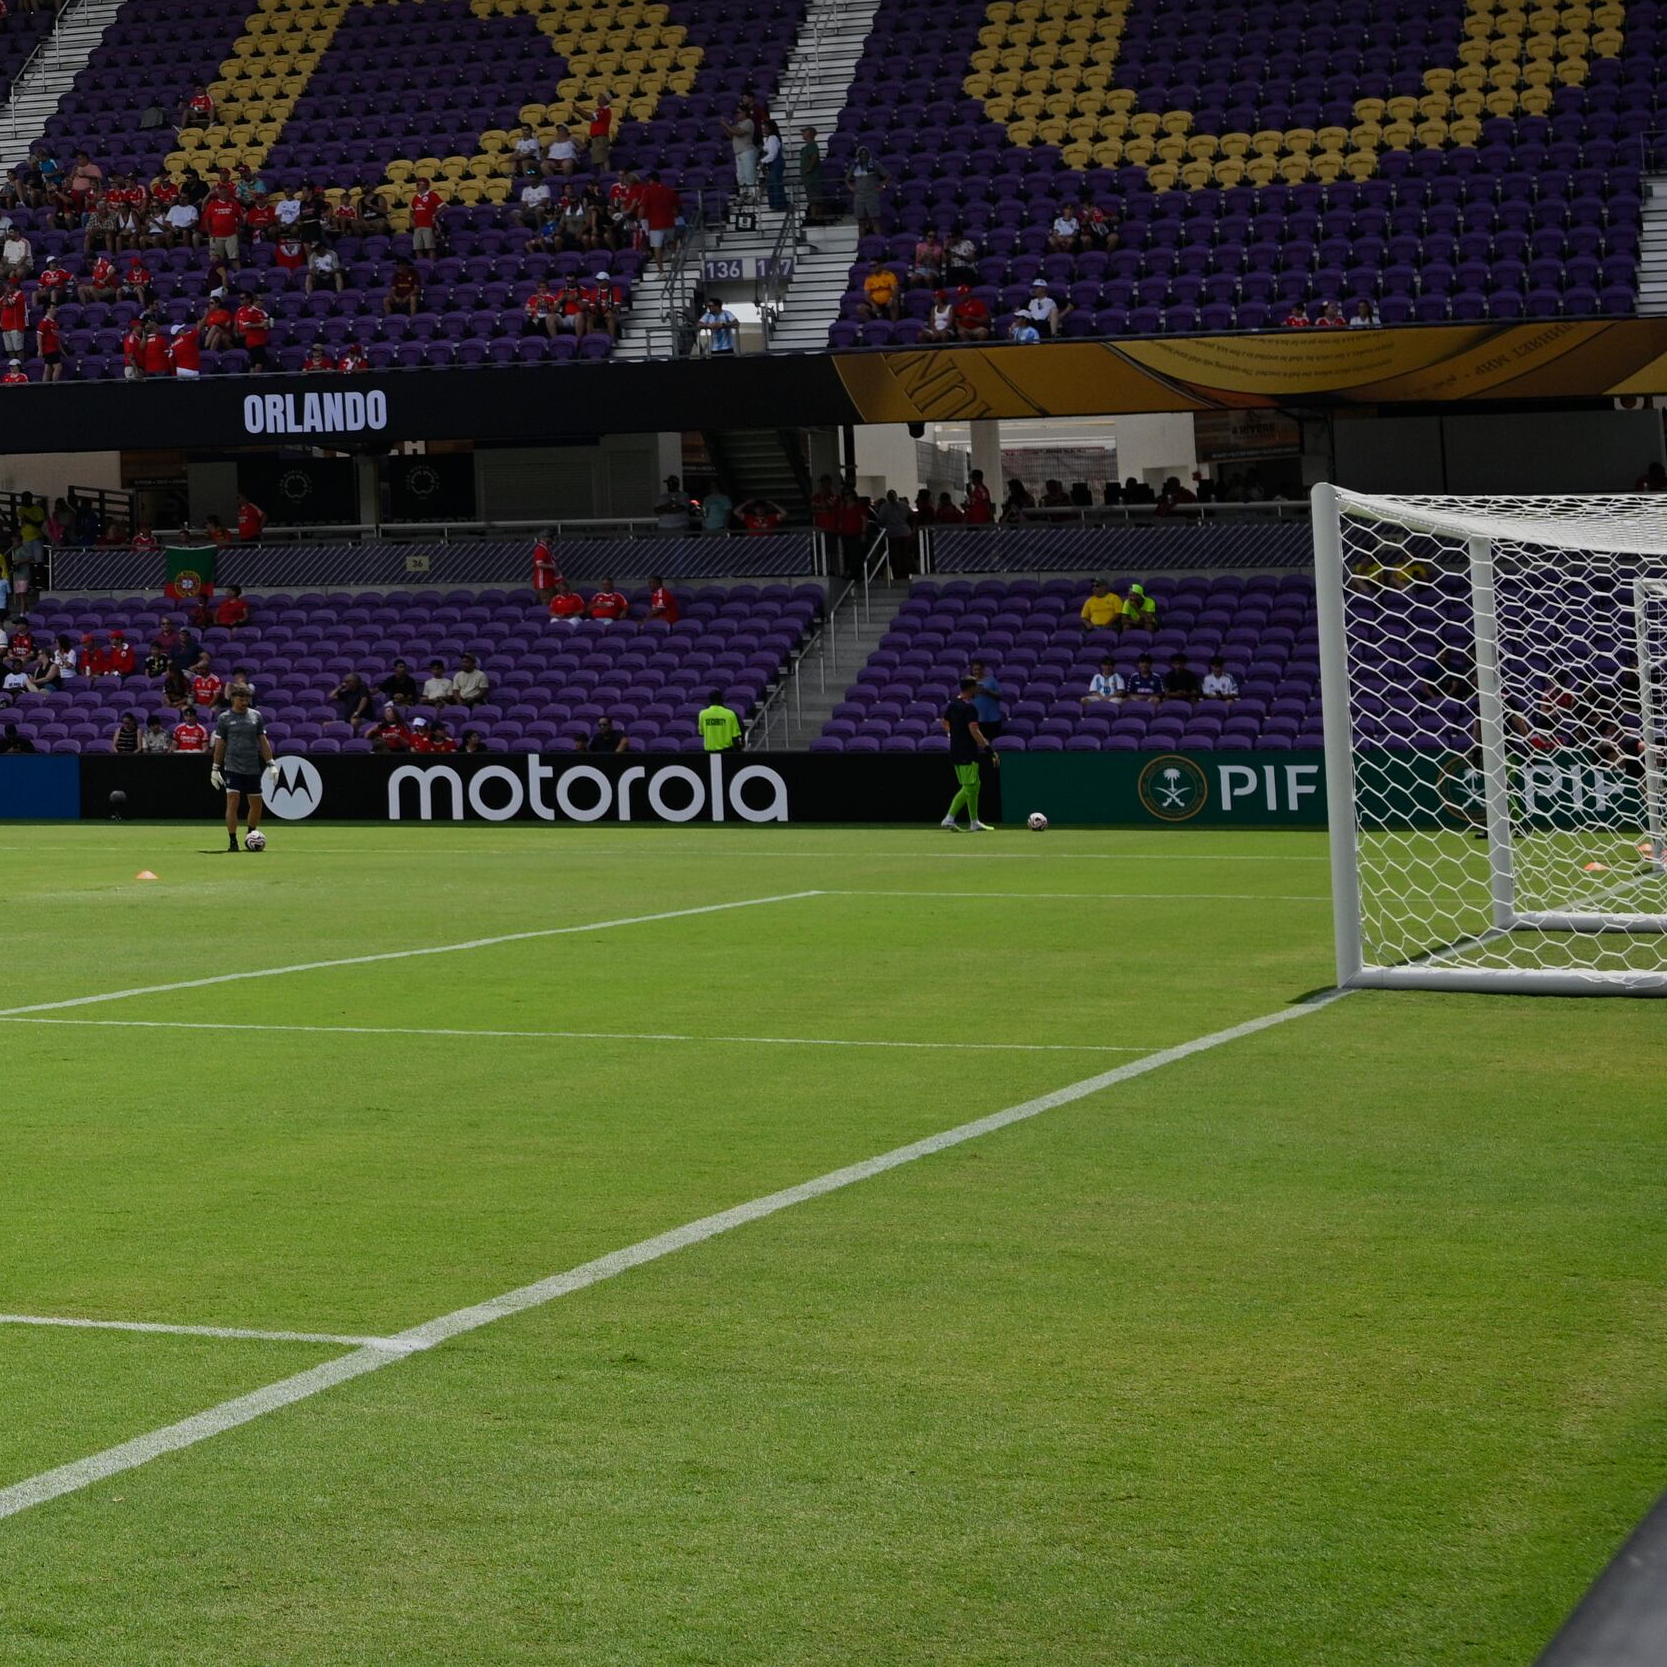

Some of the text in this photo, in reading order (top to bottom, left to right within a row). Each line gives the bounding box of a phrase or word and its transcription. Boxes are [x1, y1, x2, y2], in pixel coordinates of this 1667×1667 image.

[706, 262, 741, 278] 136
[757, 259, 793, 277] 17
[244, 389, 387, 433] ORLANDO
[387, 753, 789, 823] motorola
[1217, 764, 1320, 811] PIF
